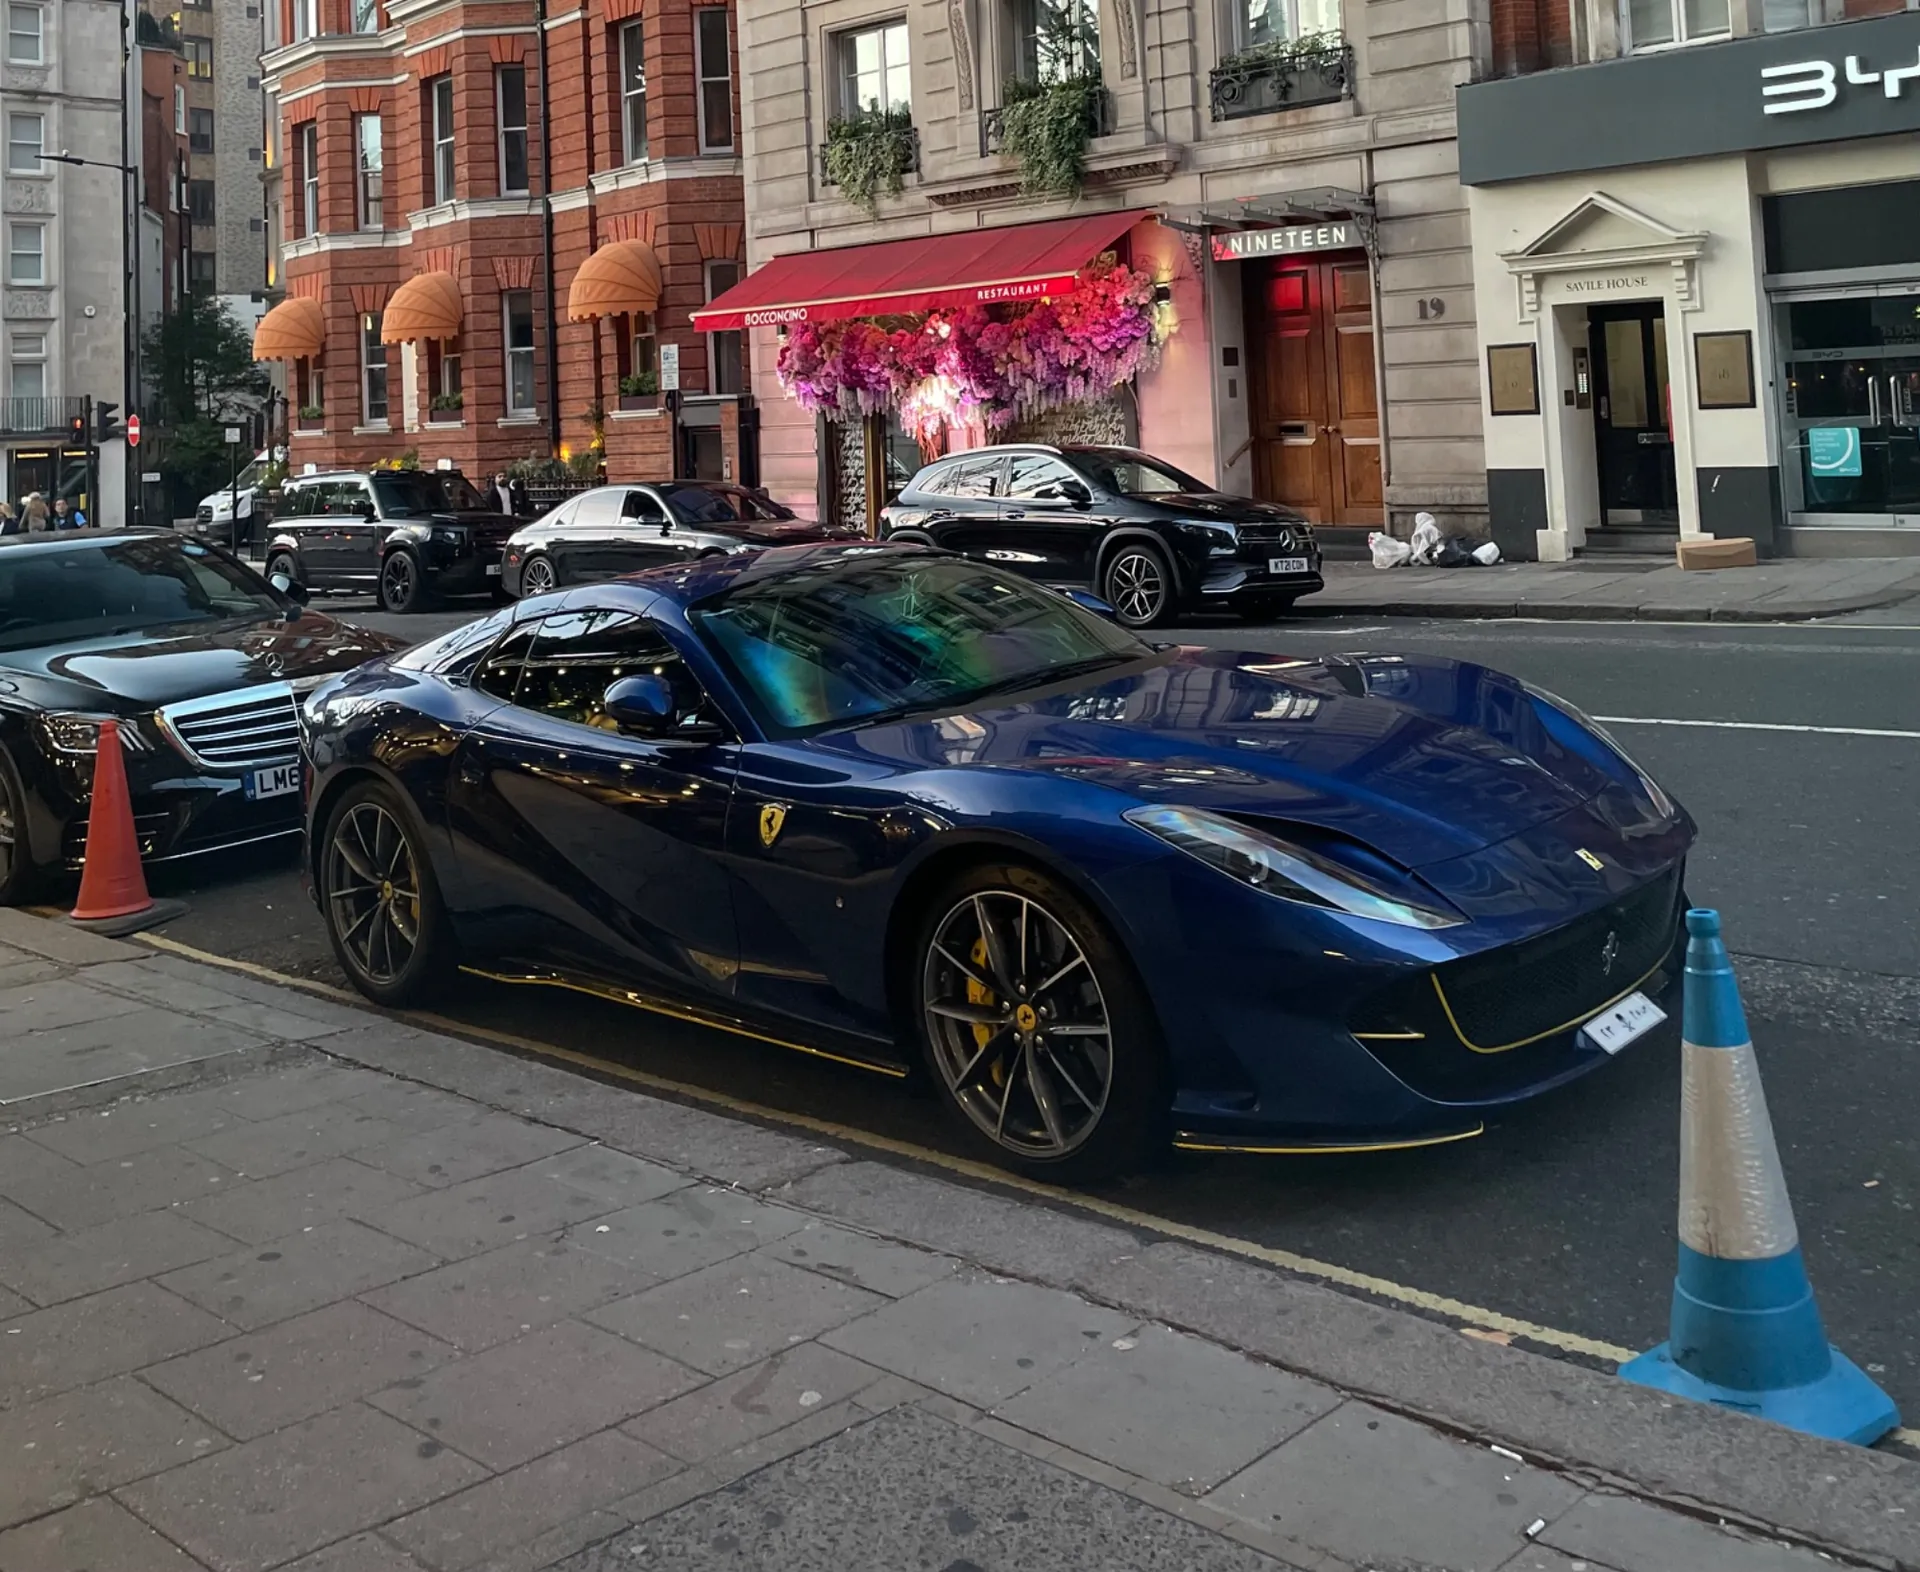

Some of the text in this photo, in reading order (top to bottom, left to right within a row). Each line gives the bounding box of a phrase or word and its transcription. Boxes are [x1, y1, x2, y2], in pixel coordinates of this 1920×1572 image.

[1230, 226, 1346, 253] NINETEEN
[977, 282, 1048, 300] RESTAURANT
[1566, 276, 1648, 292] SAVILE HOUSE
[744, 307, 808, 326] BOCCONCINO
[1417, 296, 1446, 320] 19
